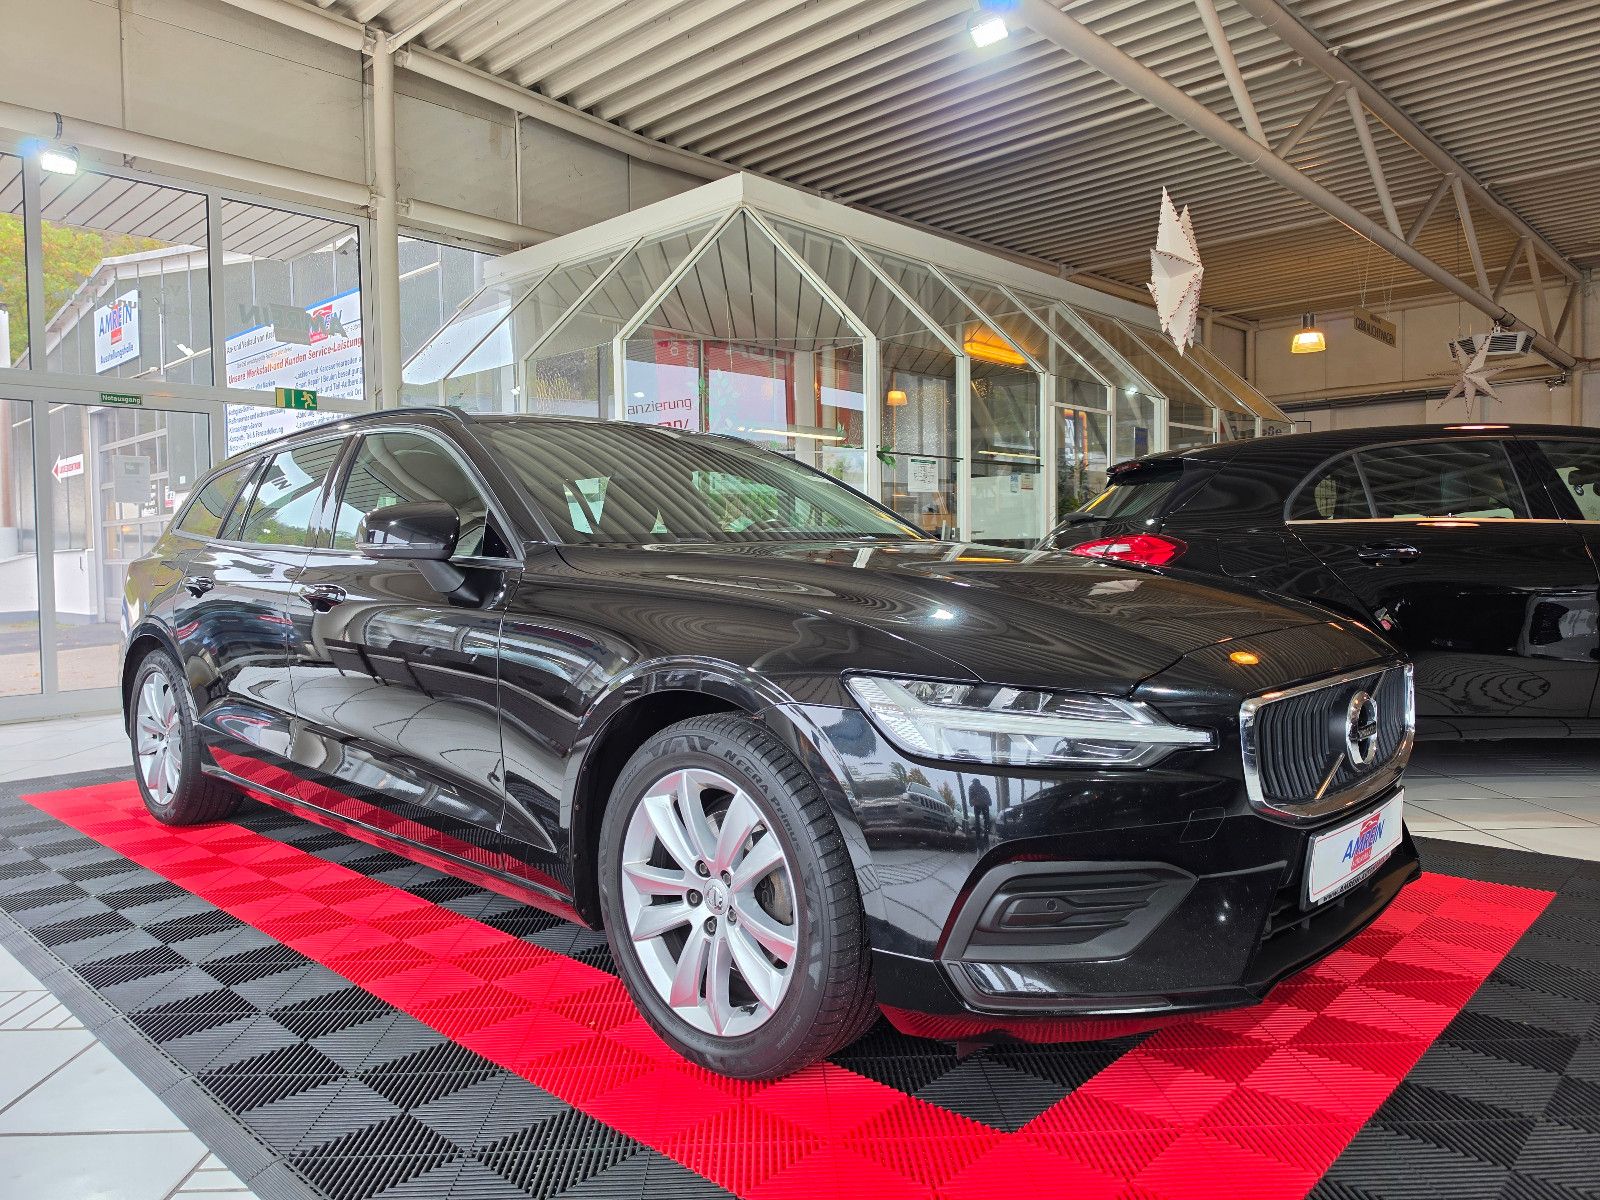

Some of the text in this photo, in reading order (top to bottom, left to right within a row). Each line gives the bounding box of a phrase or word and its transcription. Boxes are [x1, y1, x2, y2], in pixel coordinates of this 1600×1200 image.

[99, 304, 132, 336] AMREIN
[102, 394, 141, 404] Notausgang
[1342, 819, 1386, 863] AMREIN
